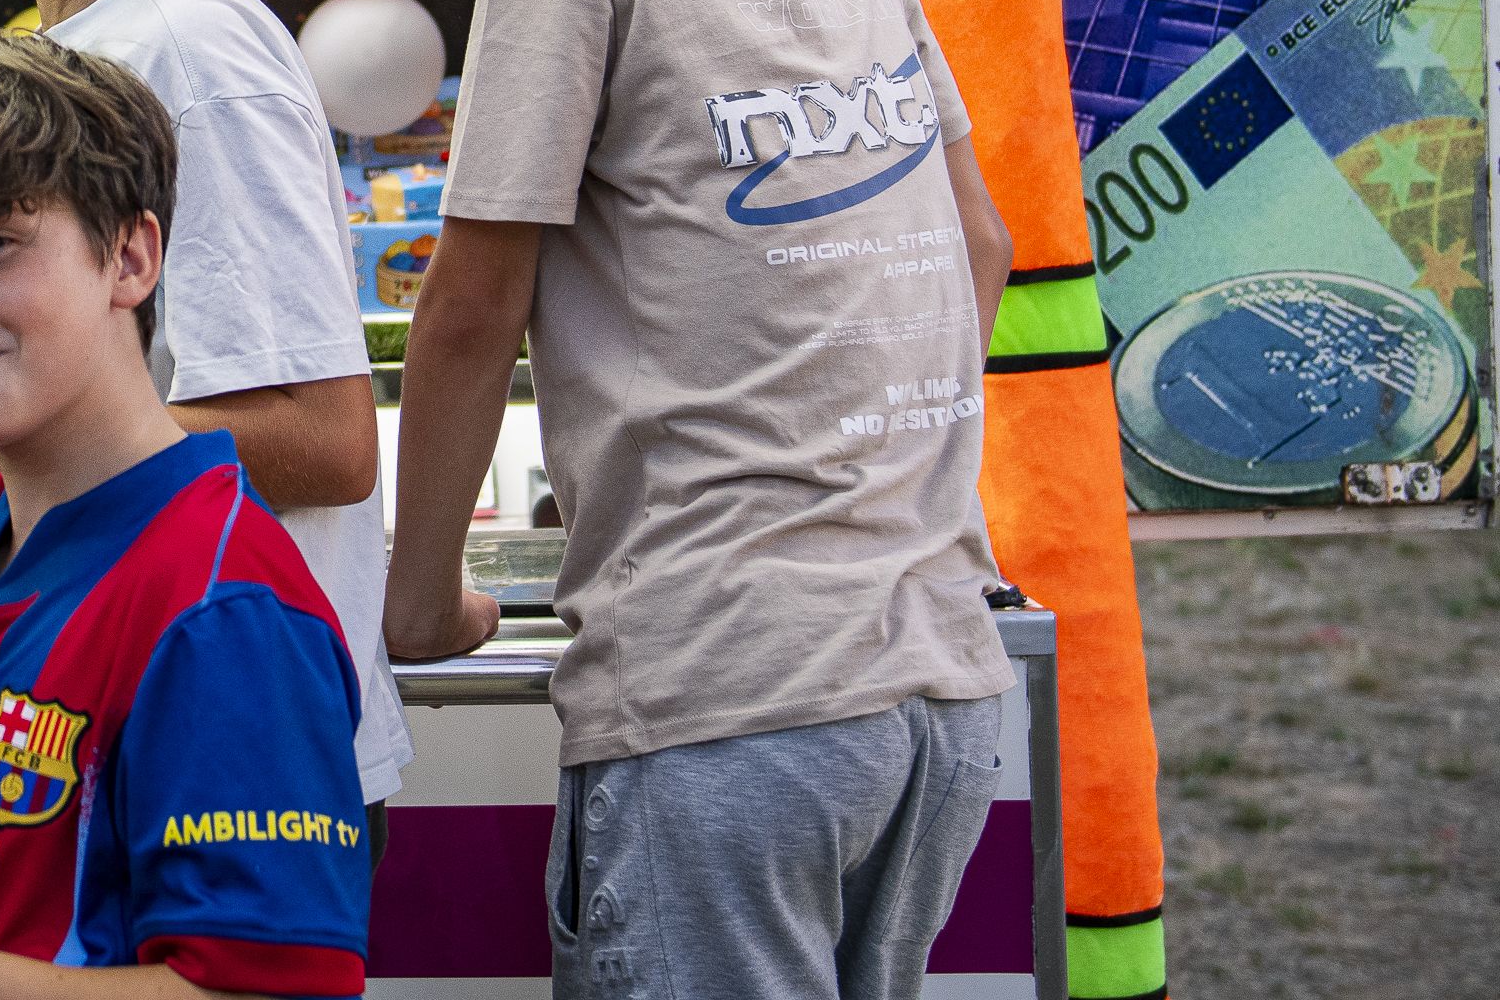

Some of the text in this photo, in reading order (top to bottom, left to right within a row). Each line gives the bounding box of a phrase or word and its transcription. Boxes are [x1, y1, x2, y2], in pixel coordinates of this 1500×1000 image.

[1280, 13, 1319, 51] BCE
[1083, 142, 1190, 276] 200
[766, 238, 893, 266] ORIGINAL
[798, 341, 826, 351] KEEP
[812, 331, 827, 341] NO
[839, 413, 885, 436] NO
[163, 809, 360, 848] AMBILIGHT tv
